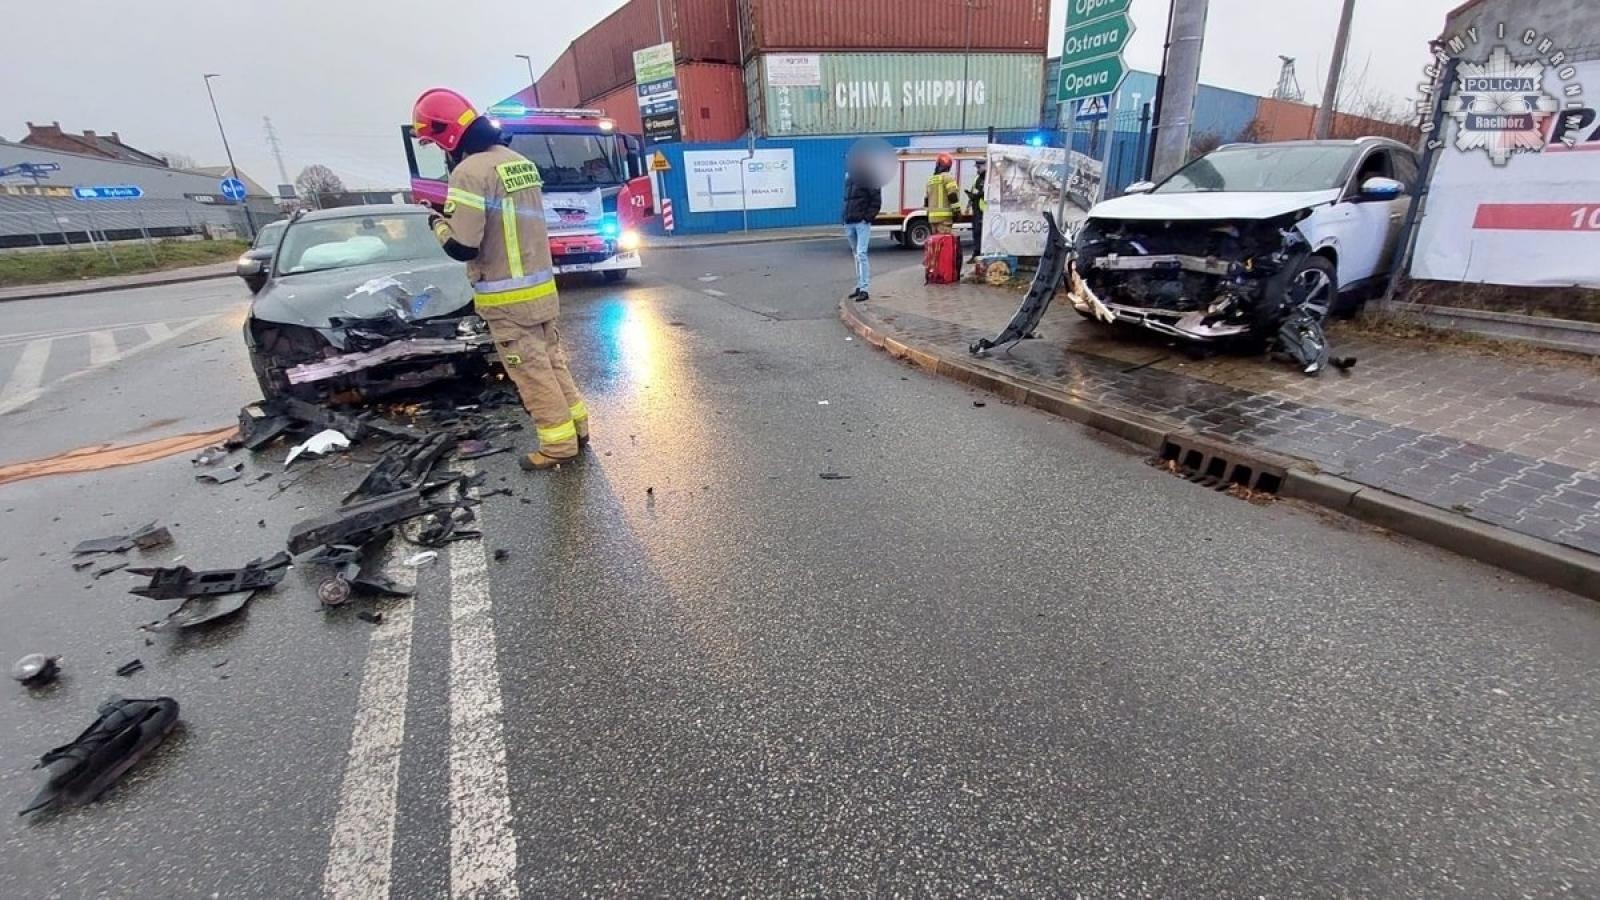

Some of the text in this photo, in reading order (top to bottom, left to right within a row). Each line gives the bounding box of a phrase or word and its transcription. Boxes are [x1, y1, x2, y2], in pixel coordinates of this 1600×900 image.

[1066, 29, 1119, 54] Ostrava
[836, 80, 985, 108] CHINA SHIPPING
[1065, 71, 1109, 94] Opava
